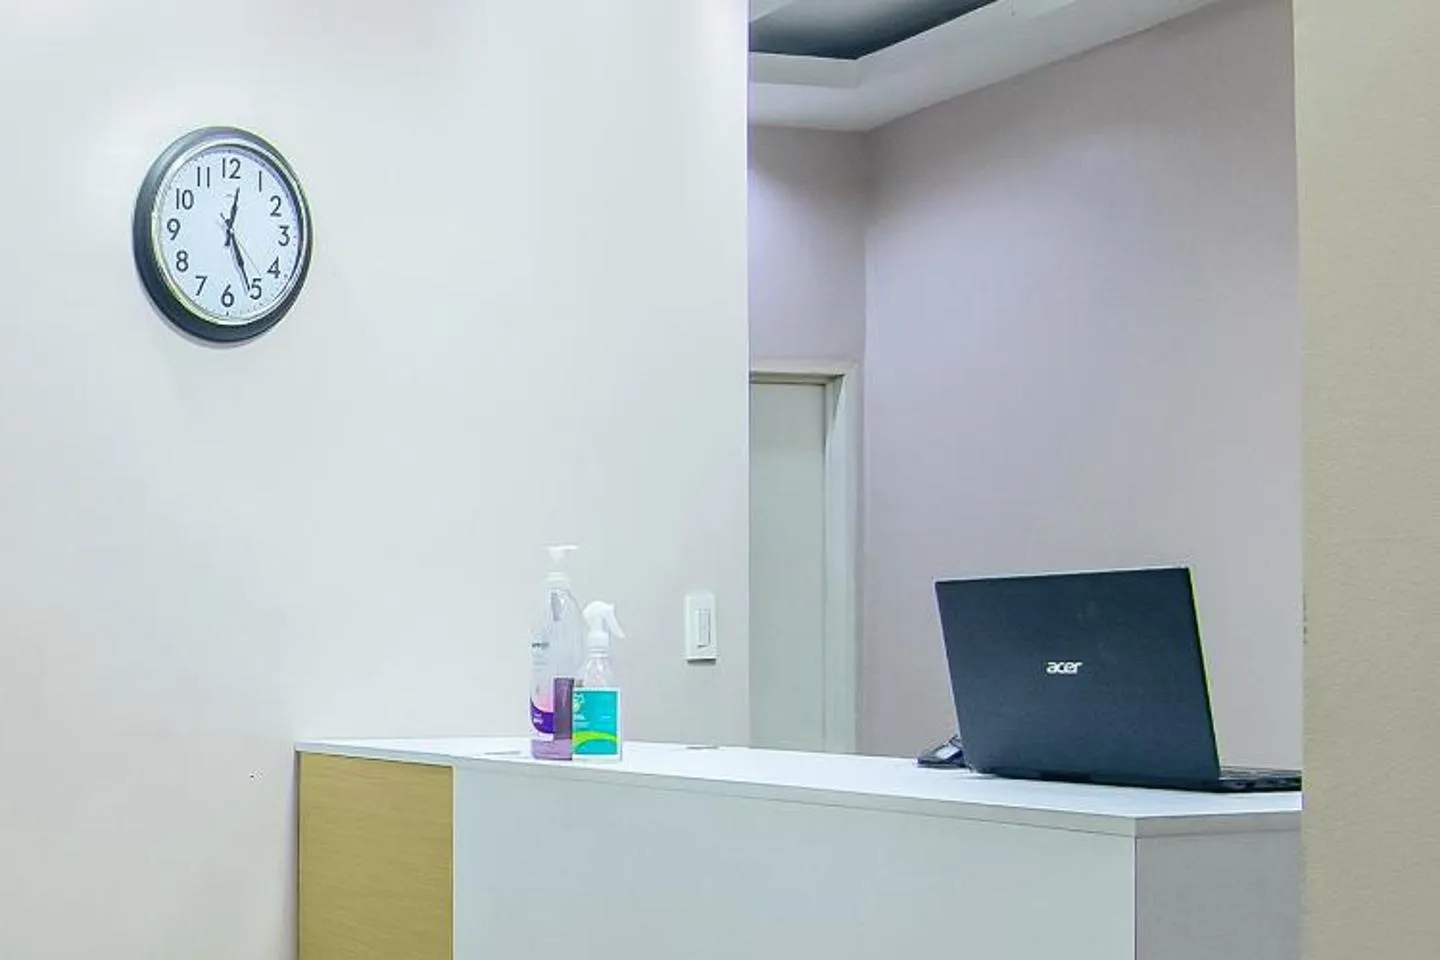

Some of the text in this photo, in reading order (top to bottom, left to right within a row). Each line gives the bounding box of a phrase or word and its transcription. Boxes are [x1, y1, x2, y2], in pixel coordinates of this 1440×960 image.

[196, 166, 210, 188] 11
[221, 157, 241, 179] 12
[258, 170, 262, 192] 1
[175, 188, 194, 210] 10
[269, 195, 282, 217] 2
[166, 218, 181, 240] 9
[278, 225, 290, 247] 3
[175, 250, 189, 272] 8
[266, 257, 280, 279] 4
[195, 275, 208, 296] 7
[220, 284, 235, 307] 6
[249, 278, 263, 300] 5
[1046, 661, 1083, 674] acer
